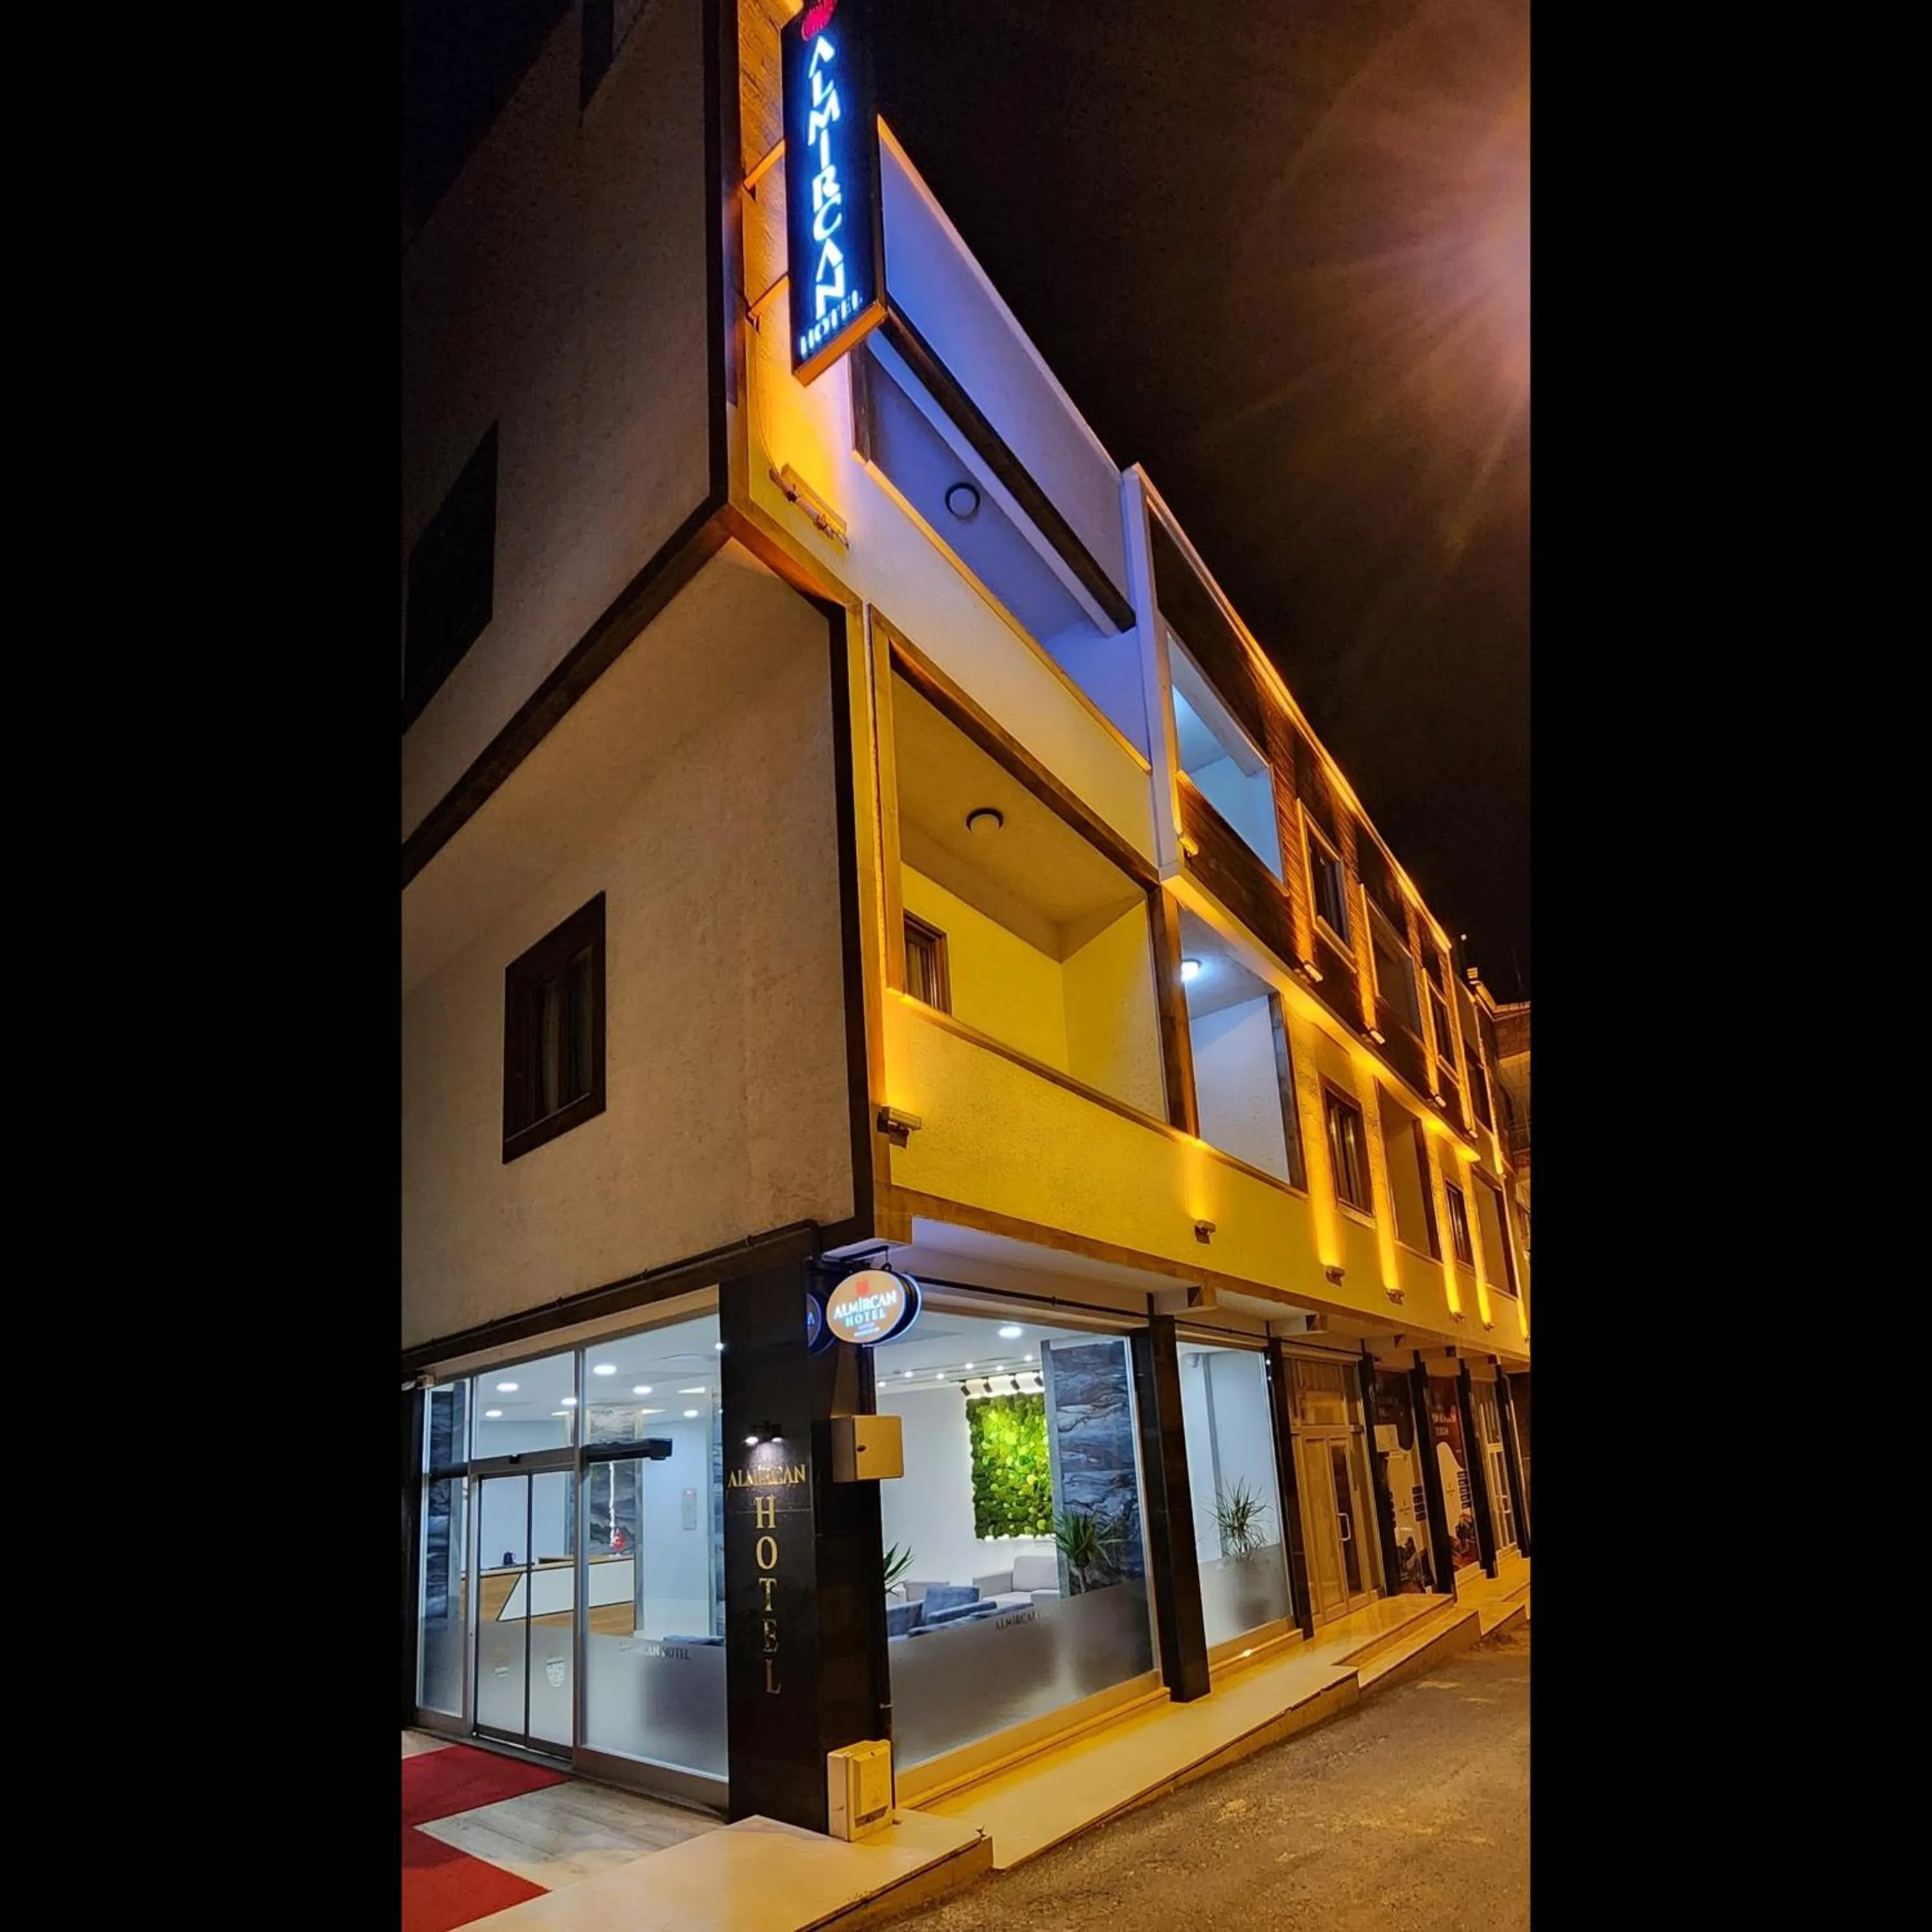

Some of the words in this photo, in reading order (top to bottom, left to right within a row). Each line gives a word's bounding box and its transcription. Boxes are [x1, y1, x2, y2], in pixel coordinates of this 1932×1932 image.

[800, 290, 862, 358] HOTEL
[845, 1307, 886, 1327] HOTEL
[755, 1495, 782, 1694] HOTEL
